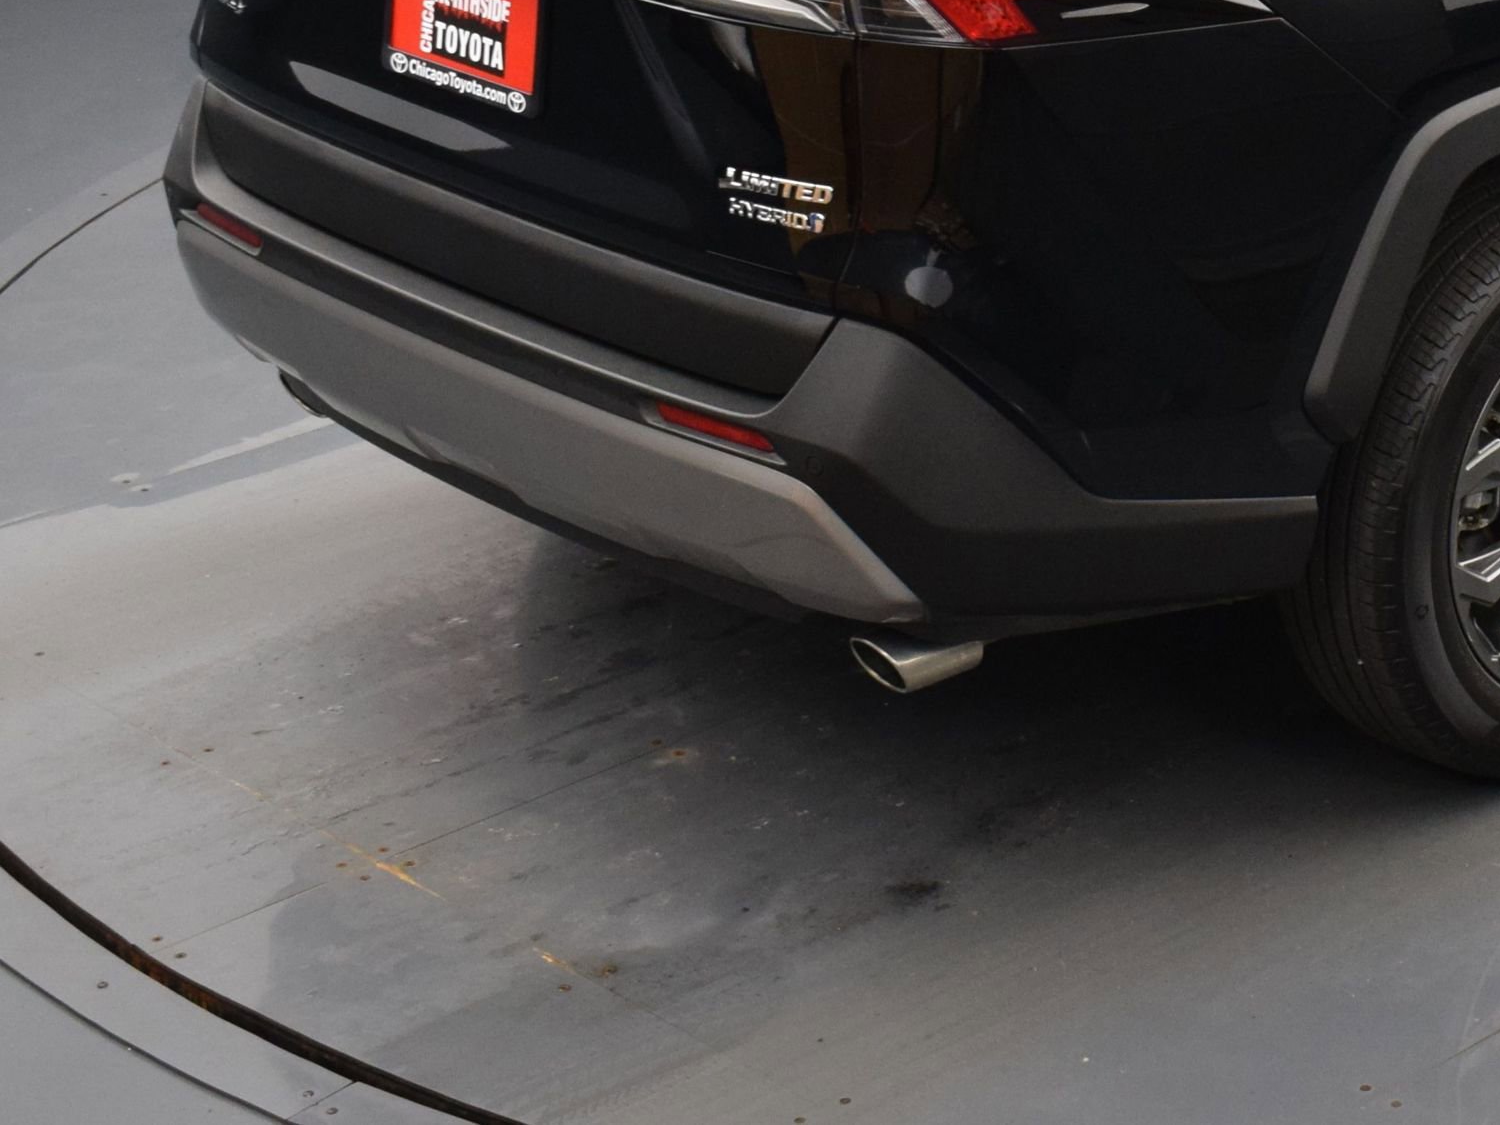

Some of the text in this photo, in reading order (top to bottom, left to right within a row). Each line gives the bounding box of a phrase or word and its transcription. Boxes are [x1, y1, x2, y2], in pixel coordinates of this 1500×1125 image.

[434, 20, 504, 71] TOYOTA
[409, 59, 507, 105] ChicagoToyota.com
[719, 166, 833, 205] LIMITED
[729, 197, 808, 230] HYBRID
